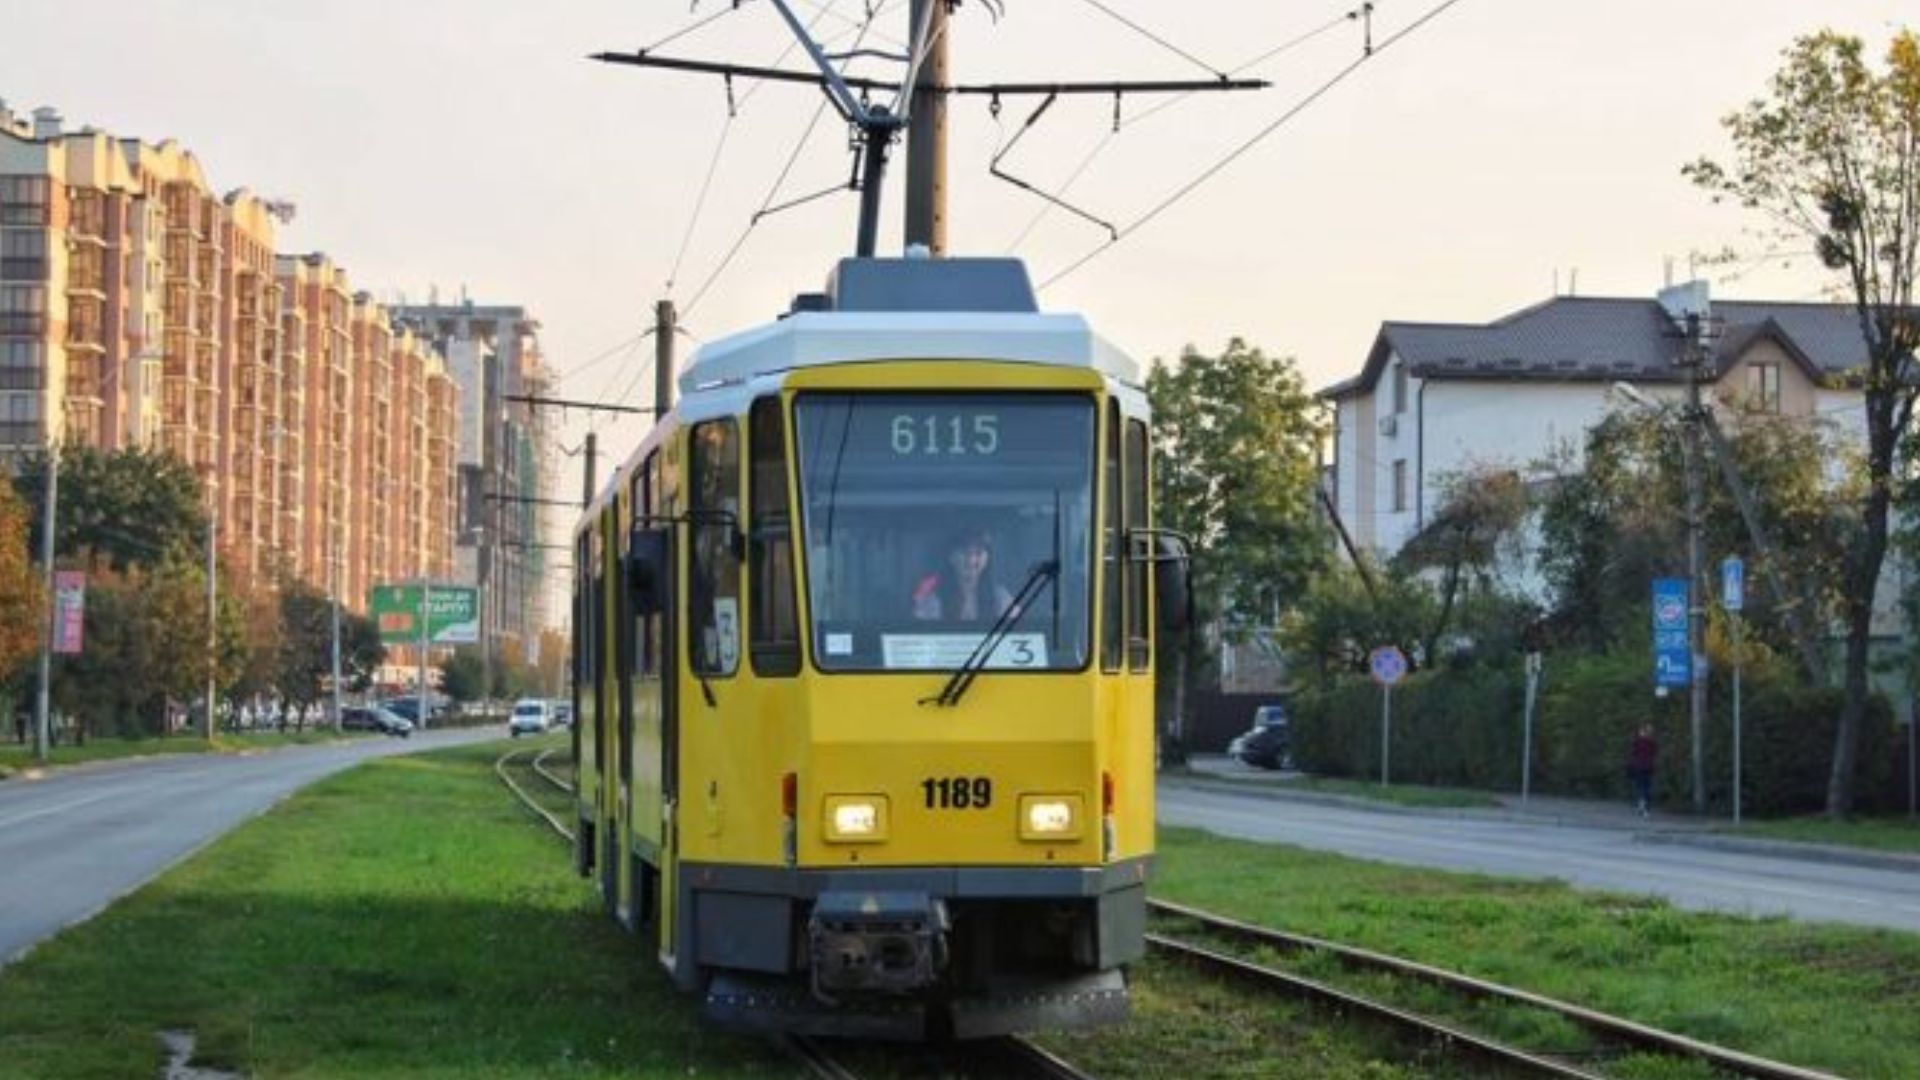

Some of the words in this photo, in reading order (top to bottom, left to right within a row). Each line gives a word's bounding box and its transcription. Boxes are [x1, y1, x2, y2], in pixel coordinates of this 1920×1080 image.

[891, 415, 998, 454] 6115
[1010, 640, 1034, 664] 3
[921, 777, 991, 809] 1189
